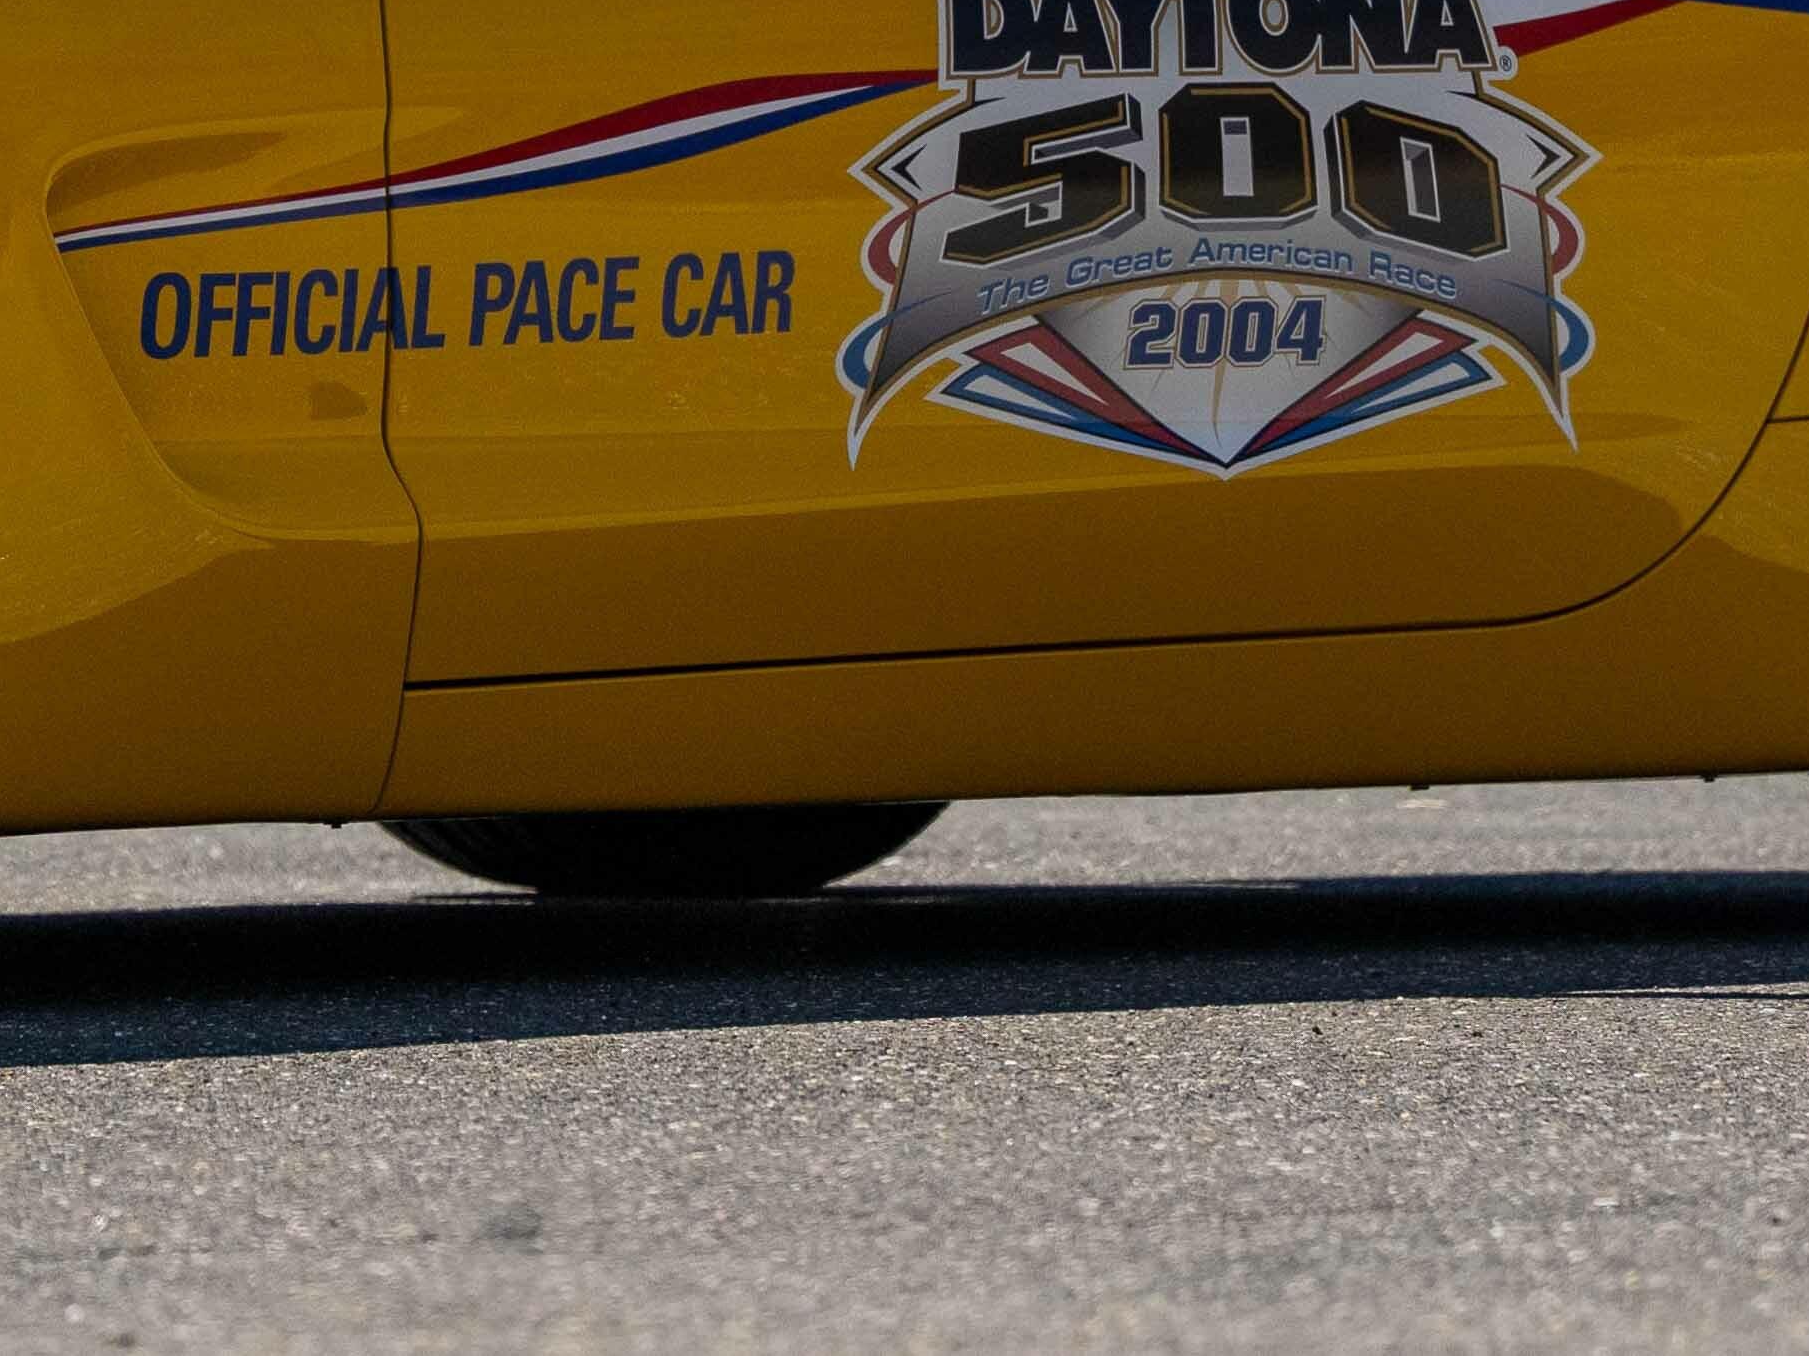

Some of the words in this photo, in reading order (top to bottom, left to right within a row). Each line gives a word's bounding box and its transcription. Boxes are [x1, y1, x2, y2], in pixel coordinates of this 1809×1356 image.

[939, 81, 1511, 263] 500
[139, 264, 447, 360] OFFICIAL
[468, 256, 641, 347] PACE
[660, 248, 797, 337] CAR
[979, 271, 1050, 315] The
[1065, 245, 1173, 288] Great
[1188, 236, 1353, 275] American
[1369, 250, 1458, 299] Race
[1123, 293, 1328, 371] 2004
